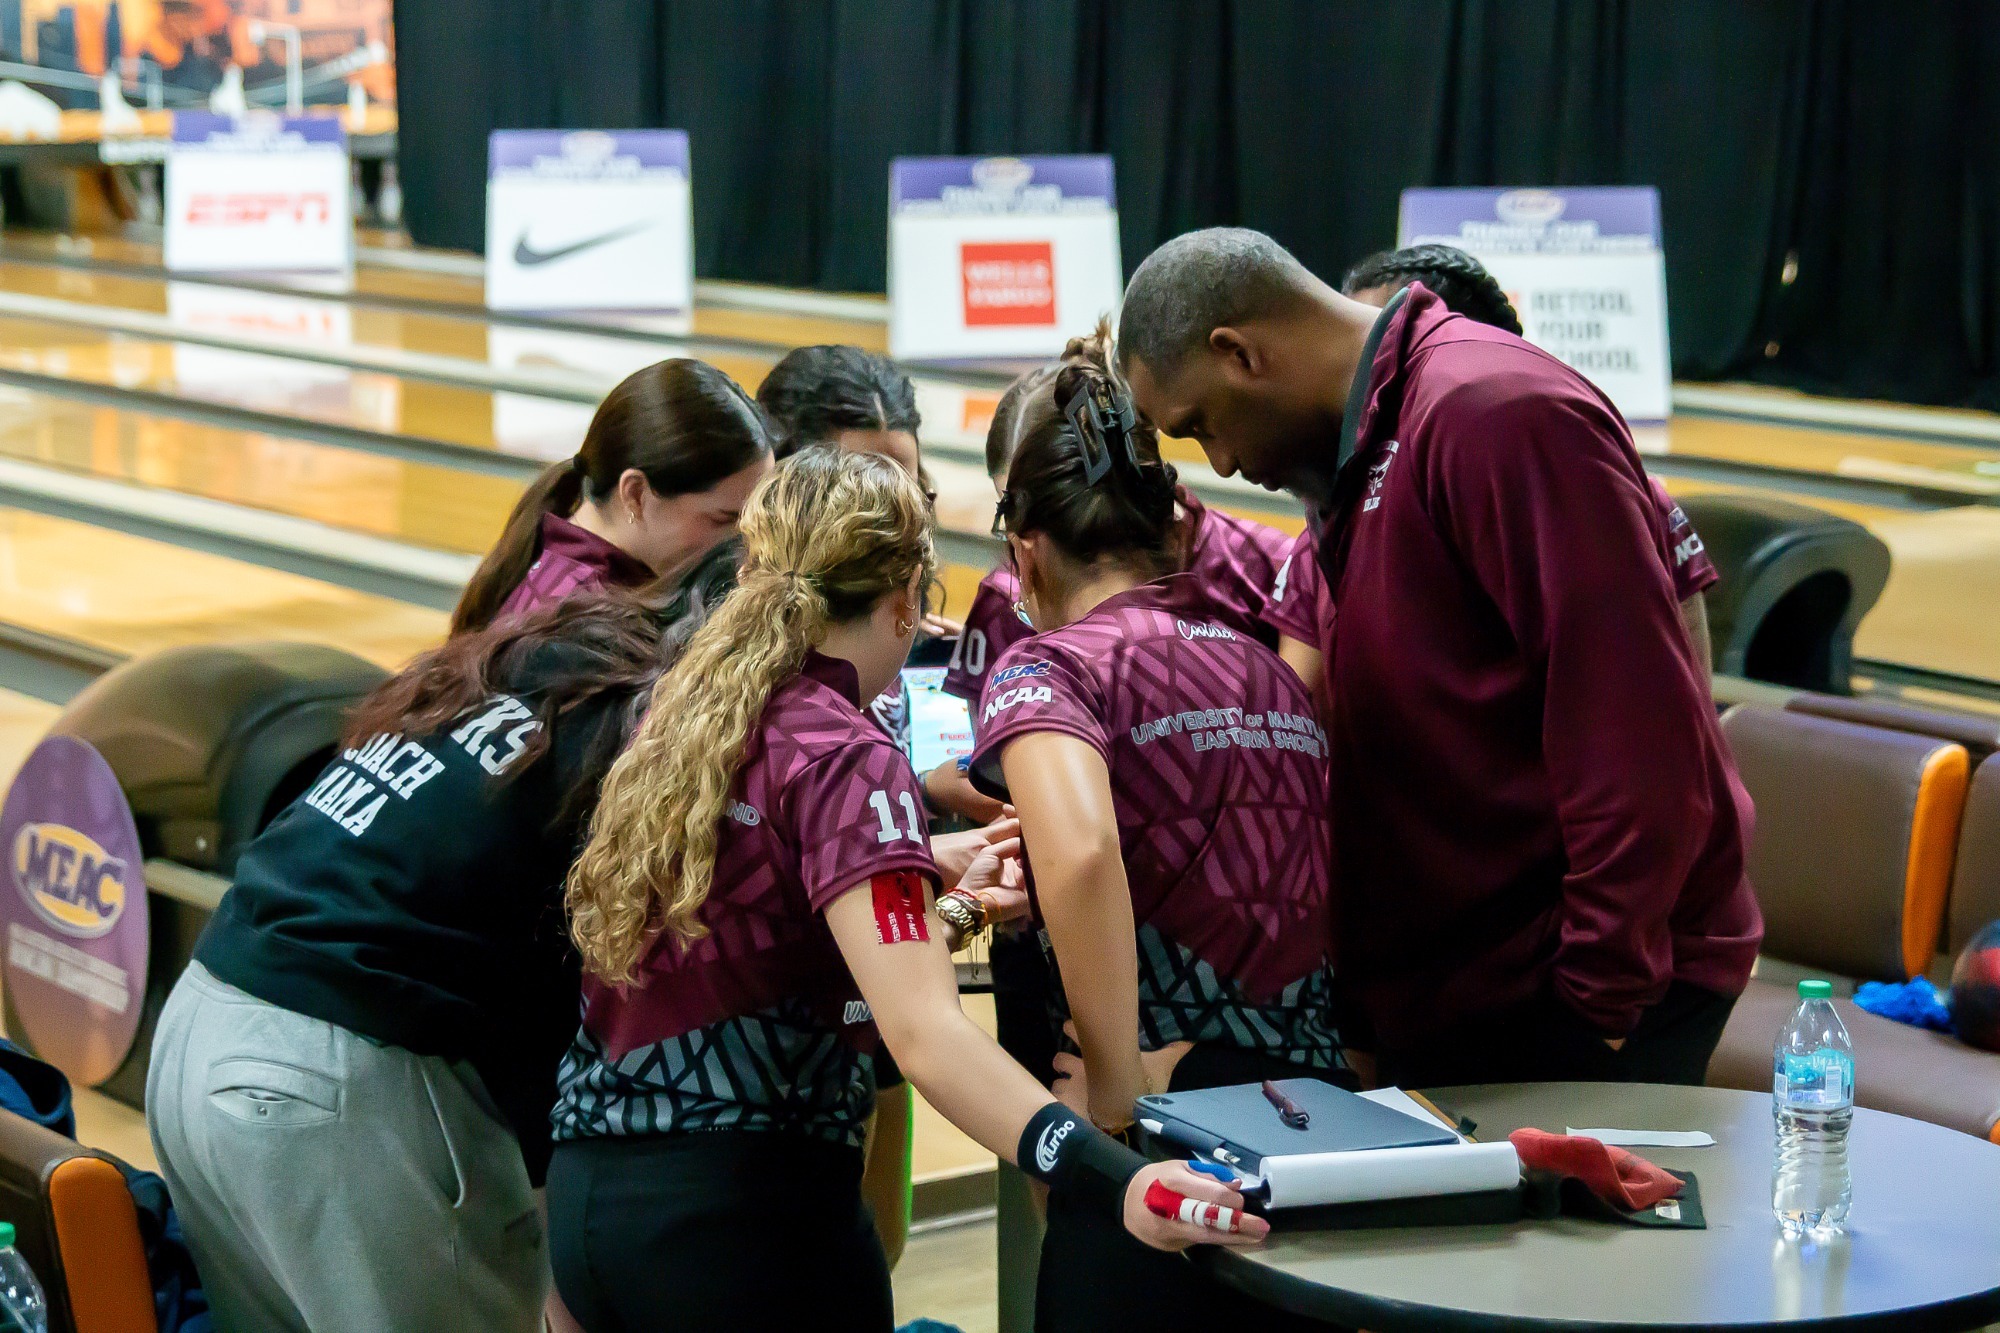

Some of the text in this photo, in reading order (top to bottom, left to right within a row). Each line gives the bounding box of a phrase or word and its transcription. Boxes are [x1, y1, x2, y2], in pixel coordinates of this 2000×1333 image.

[1531, 289, 1633, 314] RETOOL
[1537, 319, 1604, 340] YOUR
[989, 660, 1052, 693] MEAC
[983, 686, 1053, 725] NCAA
[1131, 707, 1243, 745] UNIVERSITY
[868, 789, 924, 846] 11
[23, 830, 123, 918] MEAC
[1038, 1120, 1076, 1171] Turbo
